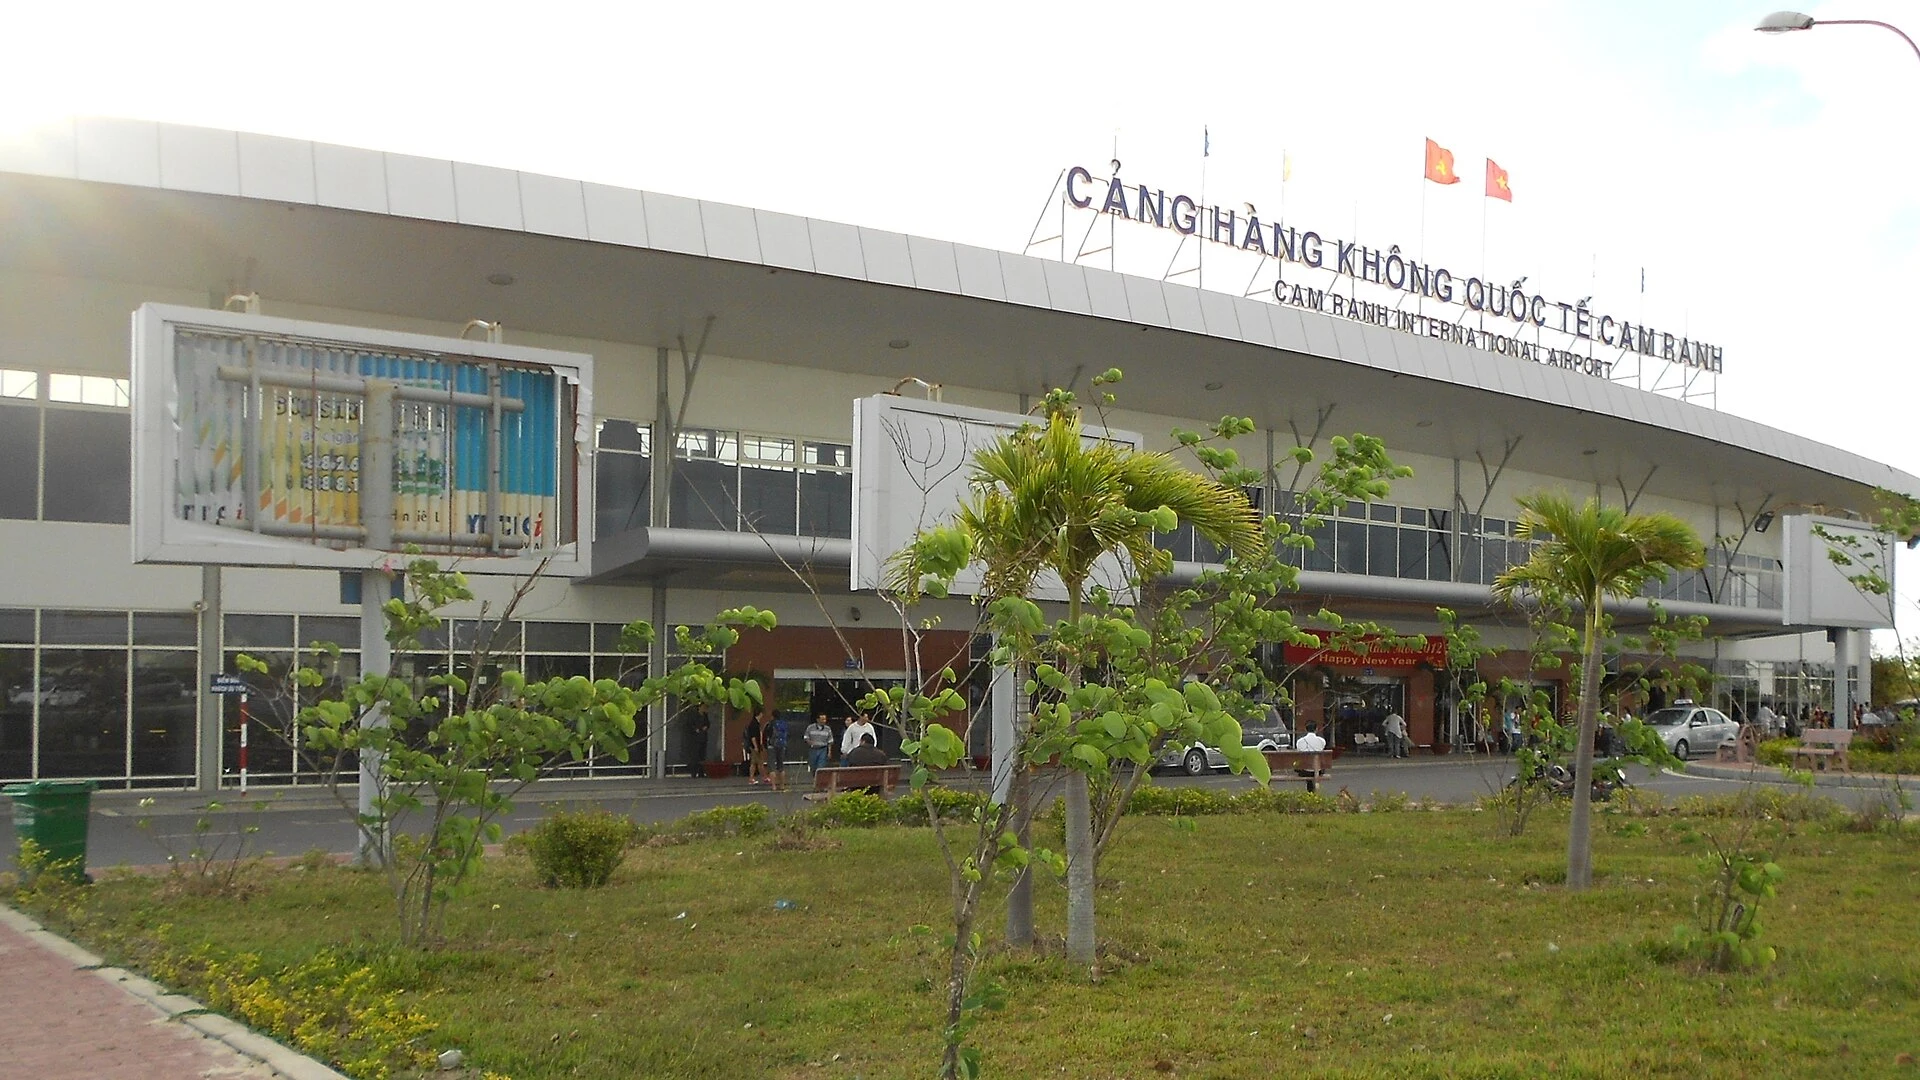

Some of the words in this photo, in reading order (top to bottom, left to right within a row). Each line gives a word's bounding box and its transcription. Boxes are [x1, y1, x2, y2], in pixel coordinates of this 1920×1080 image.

[1066, 158, 1196, 236] CẢNG
[1213, 201, 1323, 269] HÀNG
[1337, 239, 1453, 303] KHÔNG
[1465, 276, 1546, 328] QUỐC
[1557, 296, 1593, 339] TẾ
[1600, 315, 1655, 356] CAM
[1663, 332, 1723, 374] RANH
[1275, 279, 1324, 311] CAM
[1332, 293, 1389, 326] RANH
[1396, 309, 1541, 362] INTERNATIONAL
[1548, 348, 1613, 380] AIRPORT
[1319, 653, 1358, 665] Happy
[1362, 656, 1388, 665] New
[1391, 657, 1418, 666] Year
